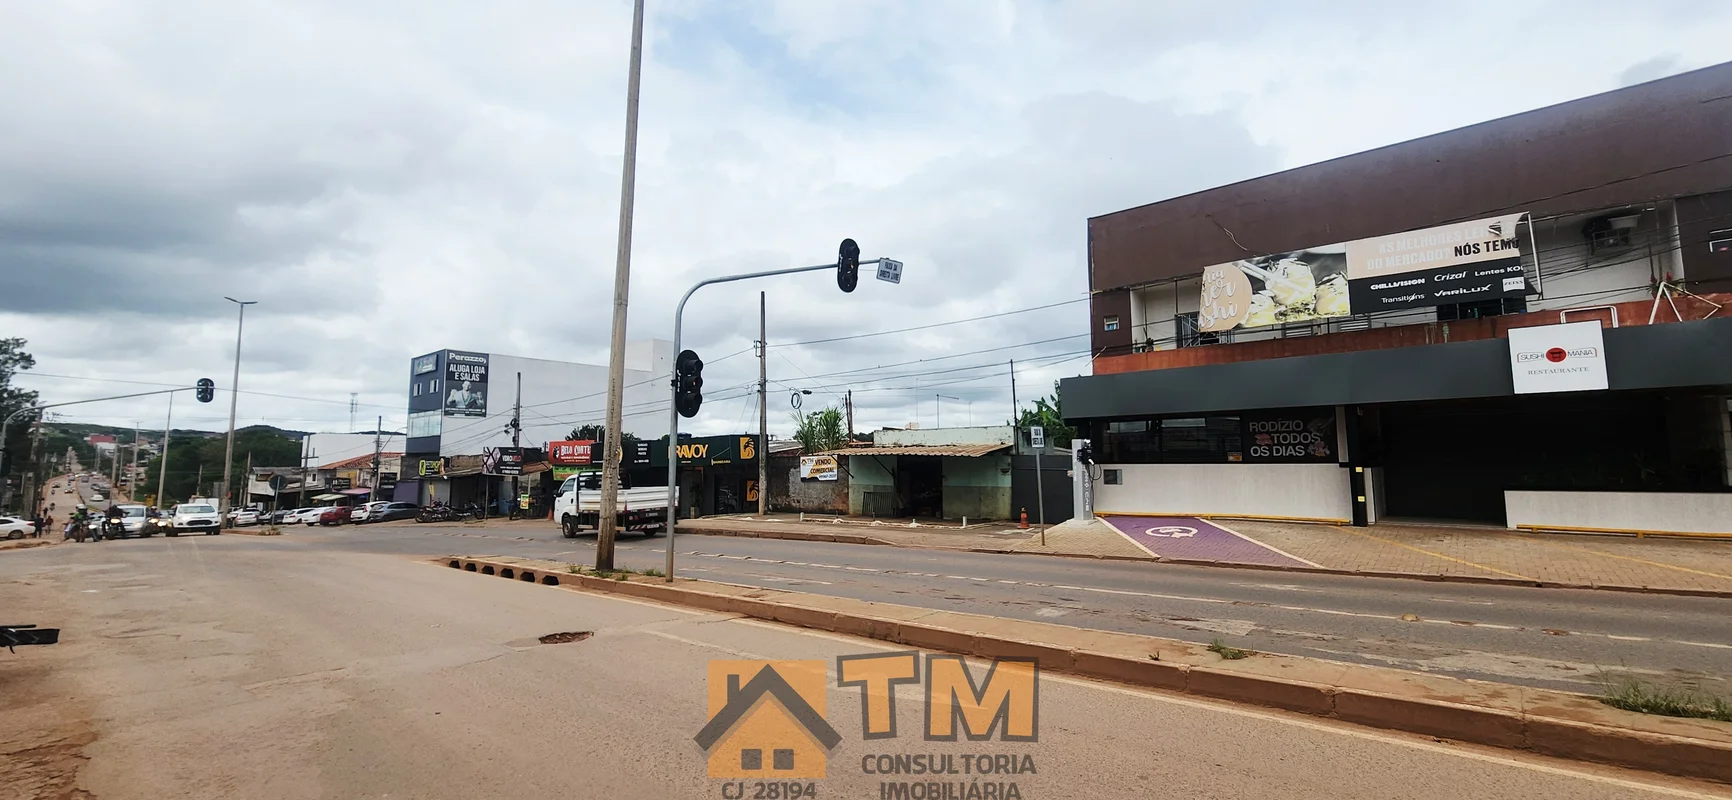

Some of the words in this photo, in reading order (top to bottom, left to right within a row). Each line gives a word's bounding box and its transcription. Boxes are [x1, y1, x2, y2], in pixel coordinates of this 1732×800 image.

[1396, 230, 1461, 252] MELHORES
[1367, 257, 1382, 270] DO
[1454, 243, 1481, 257] NÓS
[1434, 271, 1466, 282] Crizal
[1474, 268, 1505, 277] Lentes
[1381, 292, 1426, 303] Transitions
[1520, 352, 1545, 361] SUSHI
[1567, 349, 1593, 357] MANIA
[449, 363, 470, 374] ALUGA
[471, 365, 485, 375] LOJA
[1528, 366, 1590, 376] RESTAURANTE
[454, 372, 459, 380] E
[460, 372, 480, 382] SALAS
[1249, 418, 1304, 432] RODÍZIO
[1271, 432, 1321, 445] TODOS
[560, 445, 573, 456] BELO
[574, 444, 591, 456] CORTE
[668, 443, 709, 459] RAVOY
[1250, 445, 1270, 457] OS
[1272, 445, 1306, 457] DIAS
[814, 458, 832, 466] VENDO
[810, 467, 835, 475] COMERCIAL
